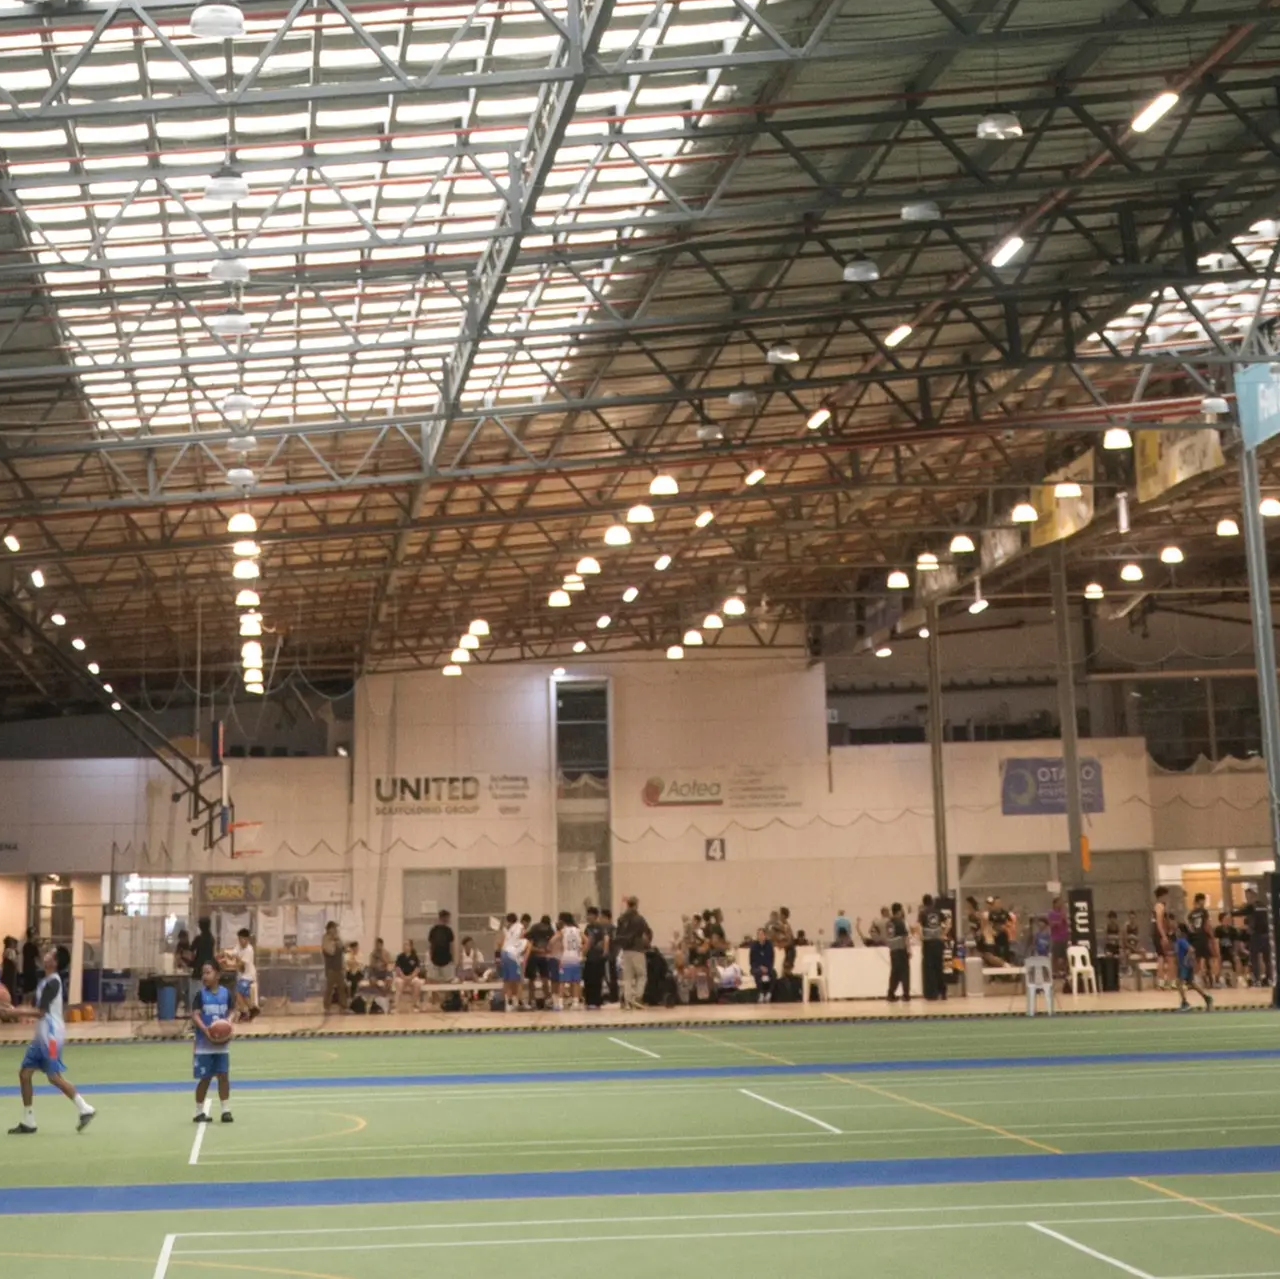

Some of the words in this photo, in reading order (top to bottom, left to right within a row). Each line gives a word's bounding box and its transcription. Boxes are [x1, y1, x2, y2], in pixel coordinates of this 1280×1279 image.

[375, 775, 480, 802] UNITED
[667, 779, 722, 798] Aotea
[708, 839, 722, 860] 4
